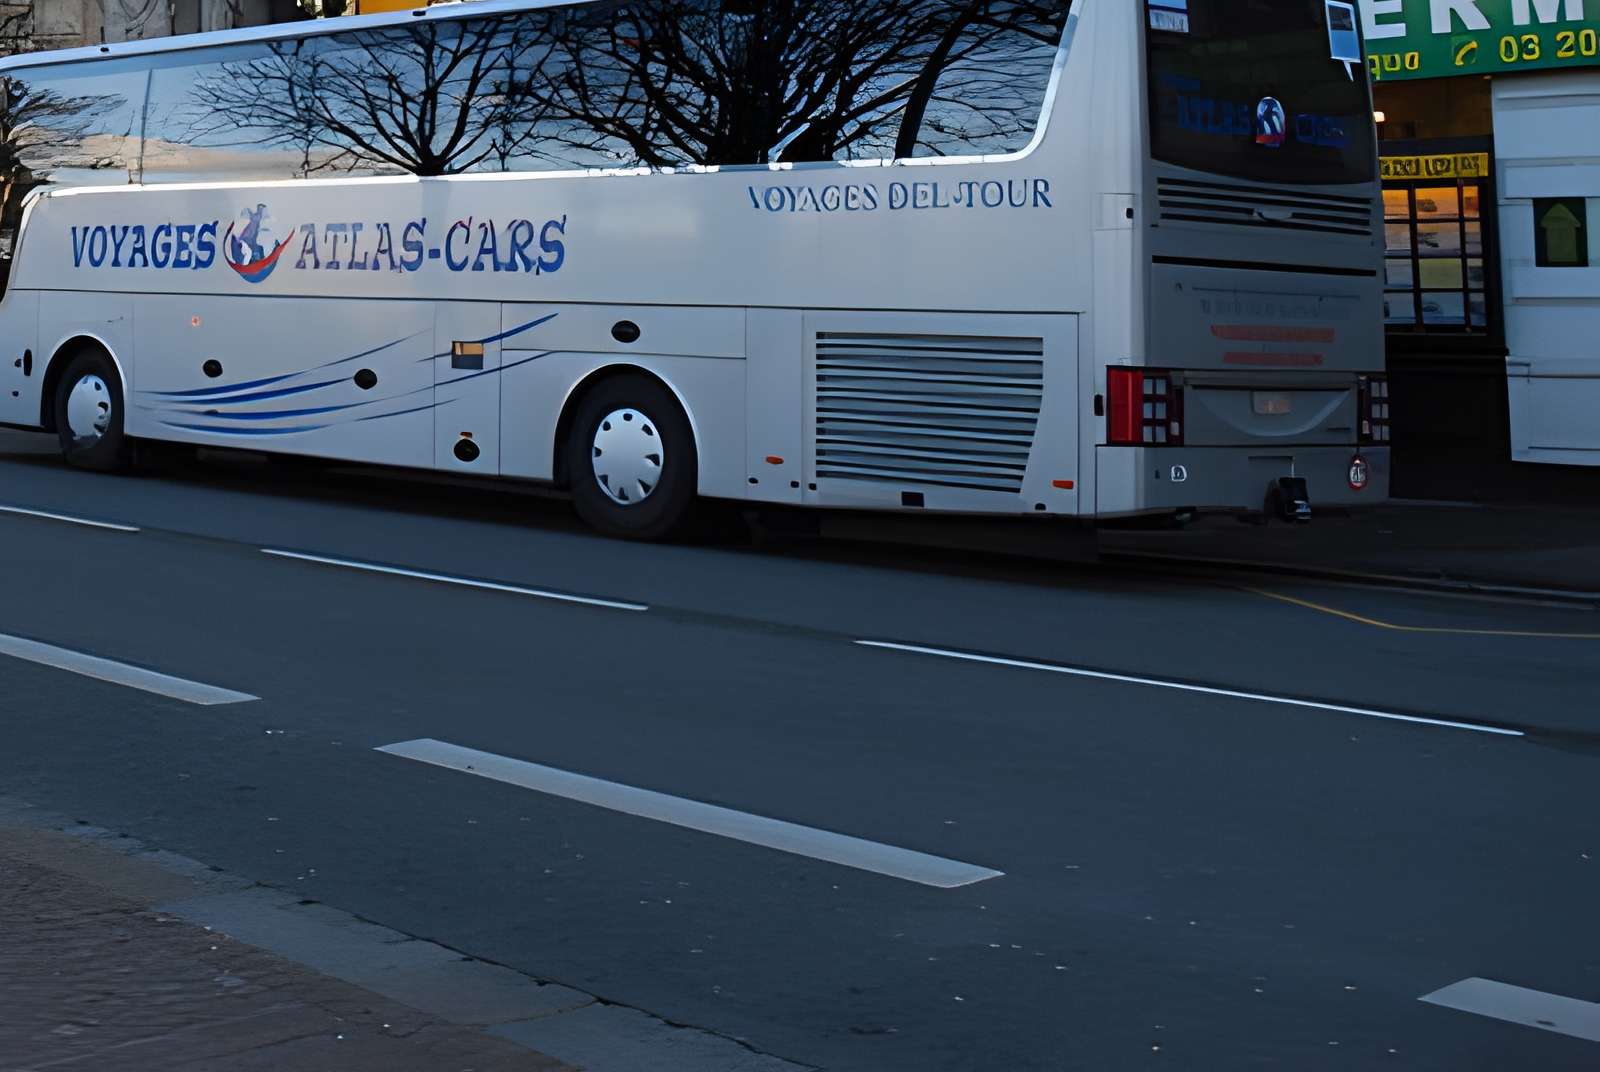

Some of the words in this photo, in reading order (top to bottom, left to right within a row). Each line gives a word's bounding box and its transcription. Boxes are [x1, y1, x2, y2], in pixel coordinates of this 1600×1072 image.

[1500, 34, 1540, 63] 03
[1556, 29, 1596, 58] 20
[747, 181, 882, 212] VOYAGES
[71, 220, 220, 270] VOYAGES
[295, 215, 567, 275] ATLAS-CARS
